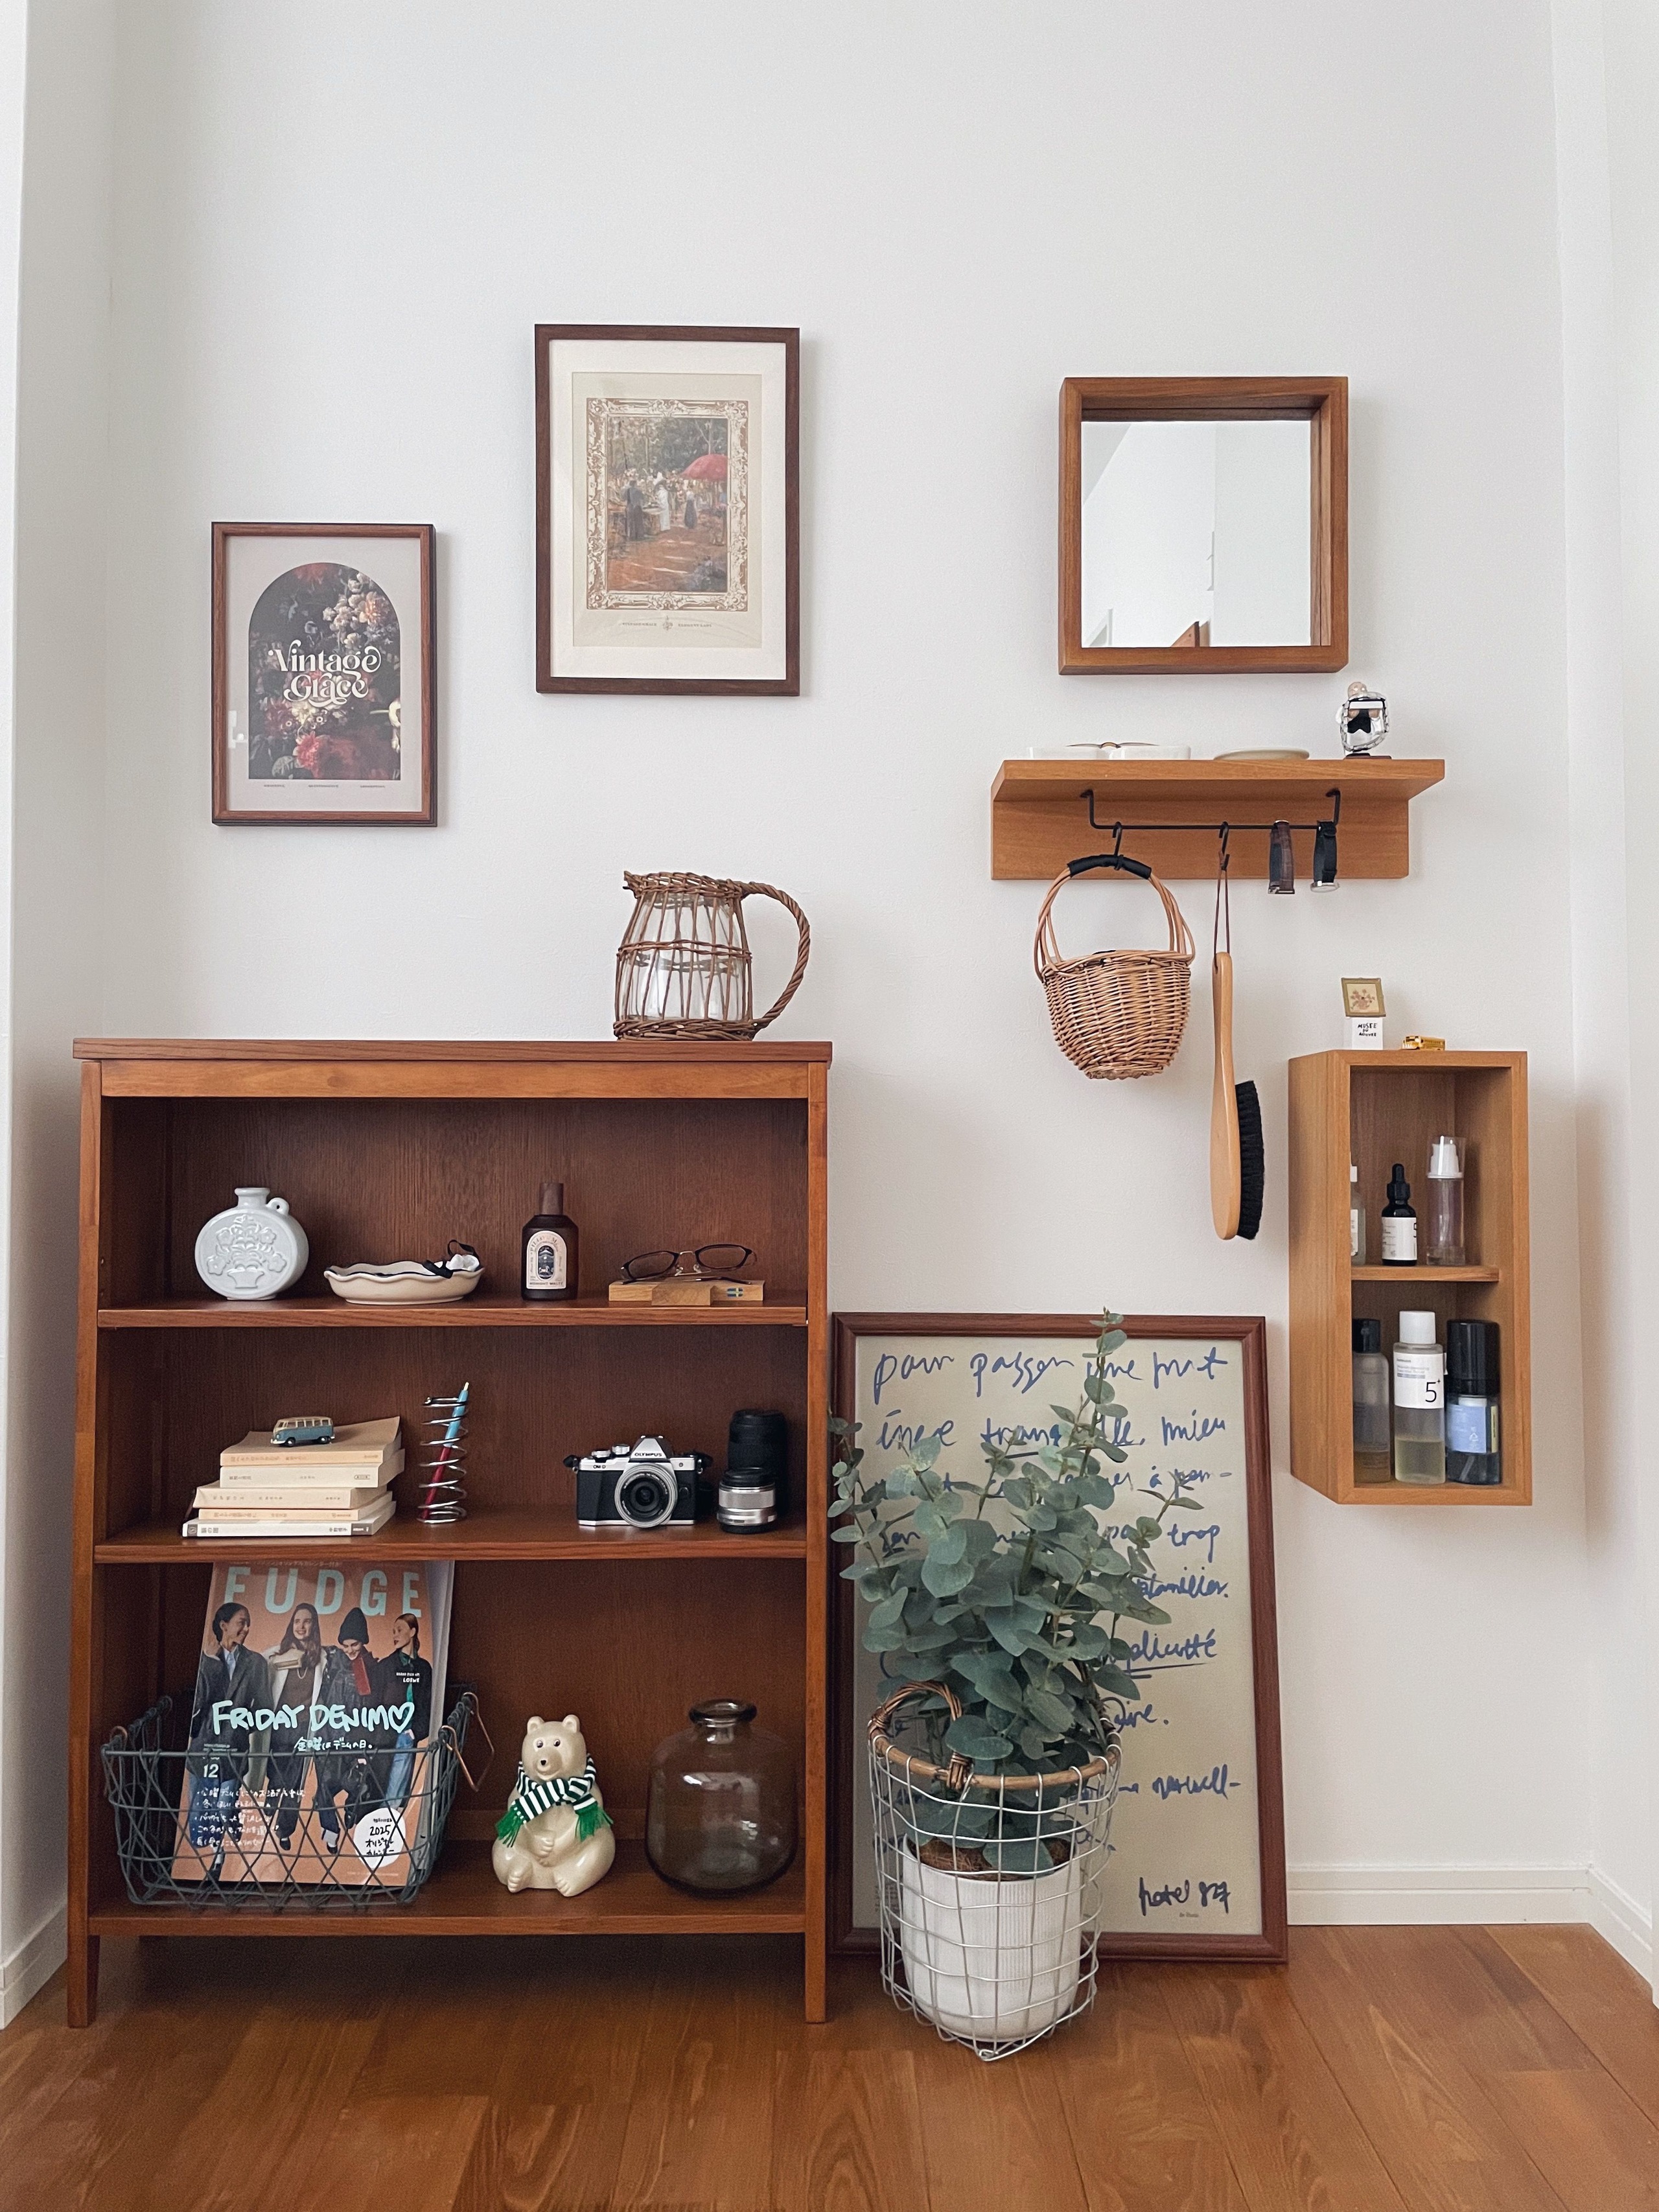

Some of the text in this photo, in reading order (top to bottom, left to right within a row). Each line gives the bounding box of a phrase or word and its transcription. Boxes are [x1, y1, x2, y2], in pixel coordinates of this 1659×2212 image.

[268, 640, 381, 680] Vintage
[283, 673, 369, 708] Grace
[223, 1566, 422, 1618] FUDGE
[212, 1700, 305, 1735] FRIDAY
[203, 1763, 219, 1778] 12
[369, 1824, 391, 1837] 2025
